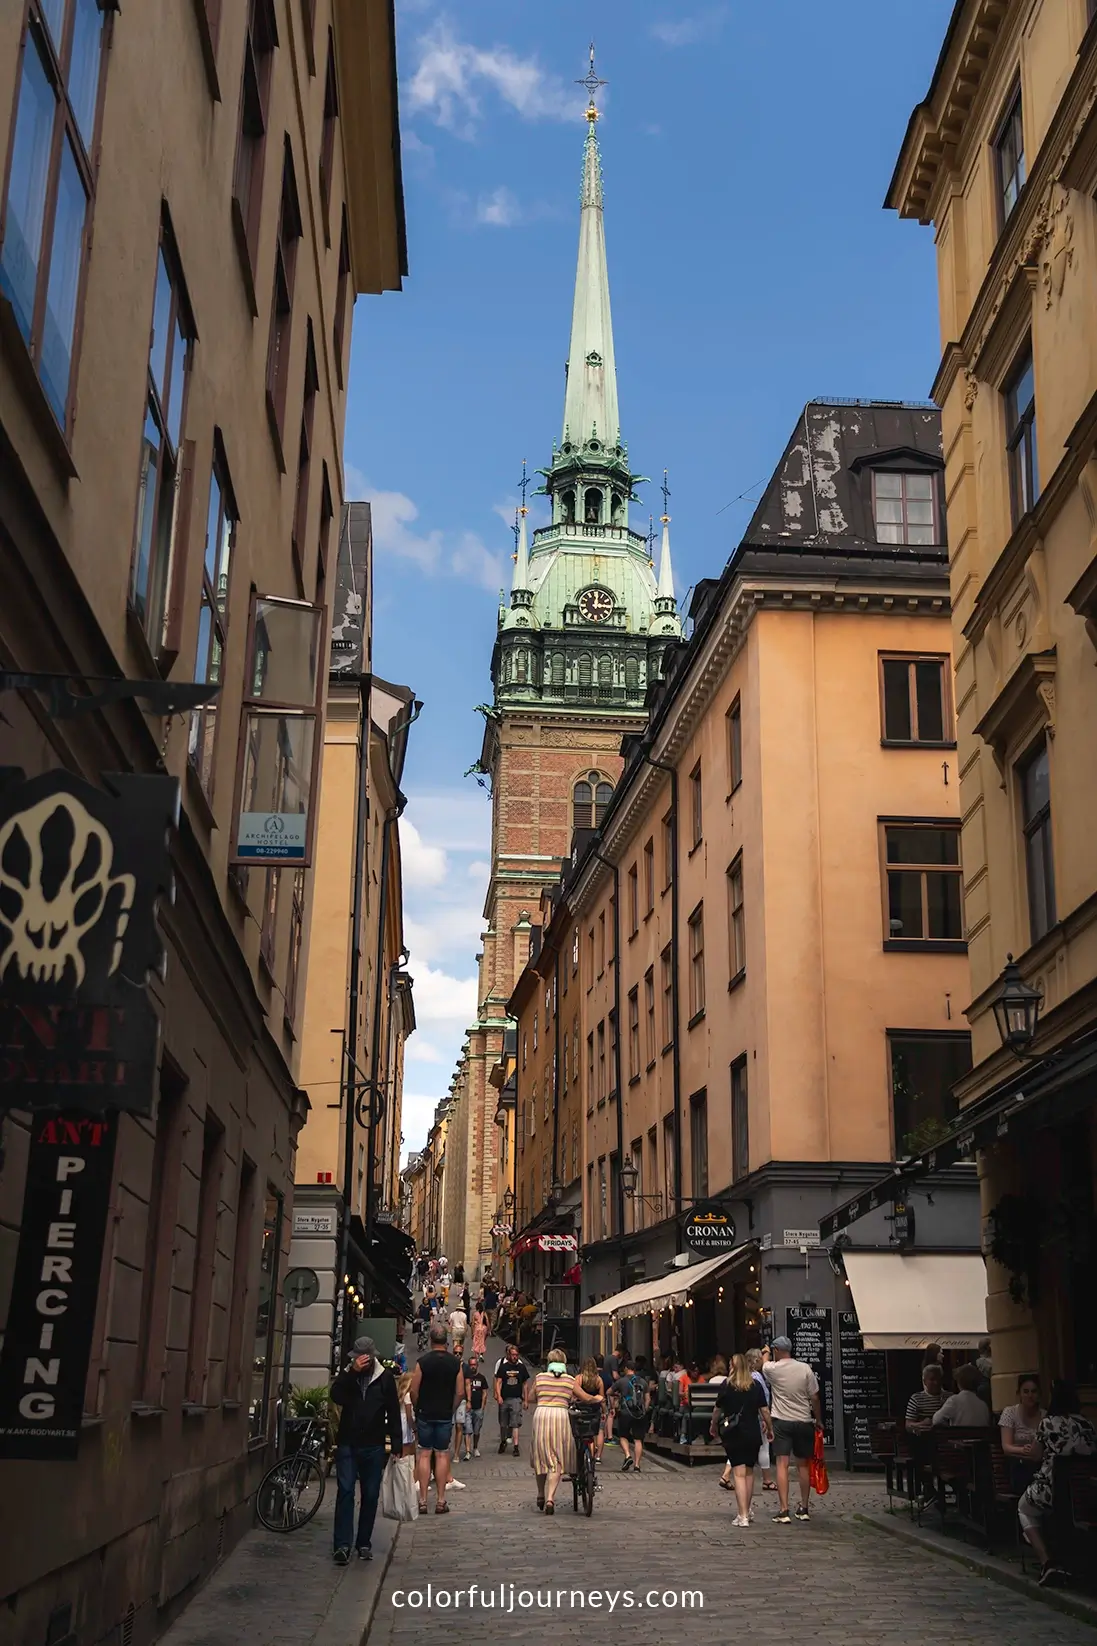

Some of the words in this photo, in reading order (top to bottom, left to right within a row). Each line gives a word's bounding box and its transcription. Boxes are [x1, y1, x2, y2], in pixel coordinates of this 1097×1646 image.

[245, 833, 300, 841] ARCHIPELAGO
[0, 1003, 127, 1051] NT
[37, 1115, 110, 1147] ANT
[686, 1225, 735, 1237] CRONAN
[690, 1238, 705, 1246] CAFÉ
[18, 1154, 86, 1420] PIERCING
